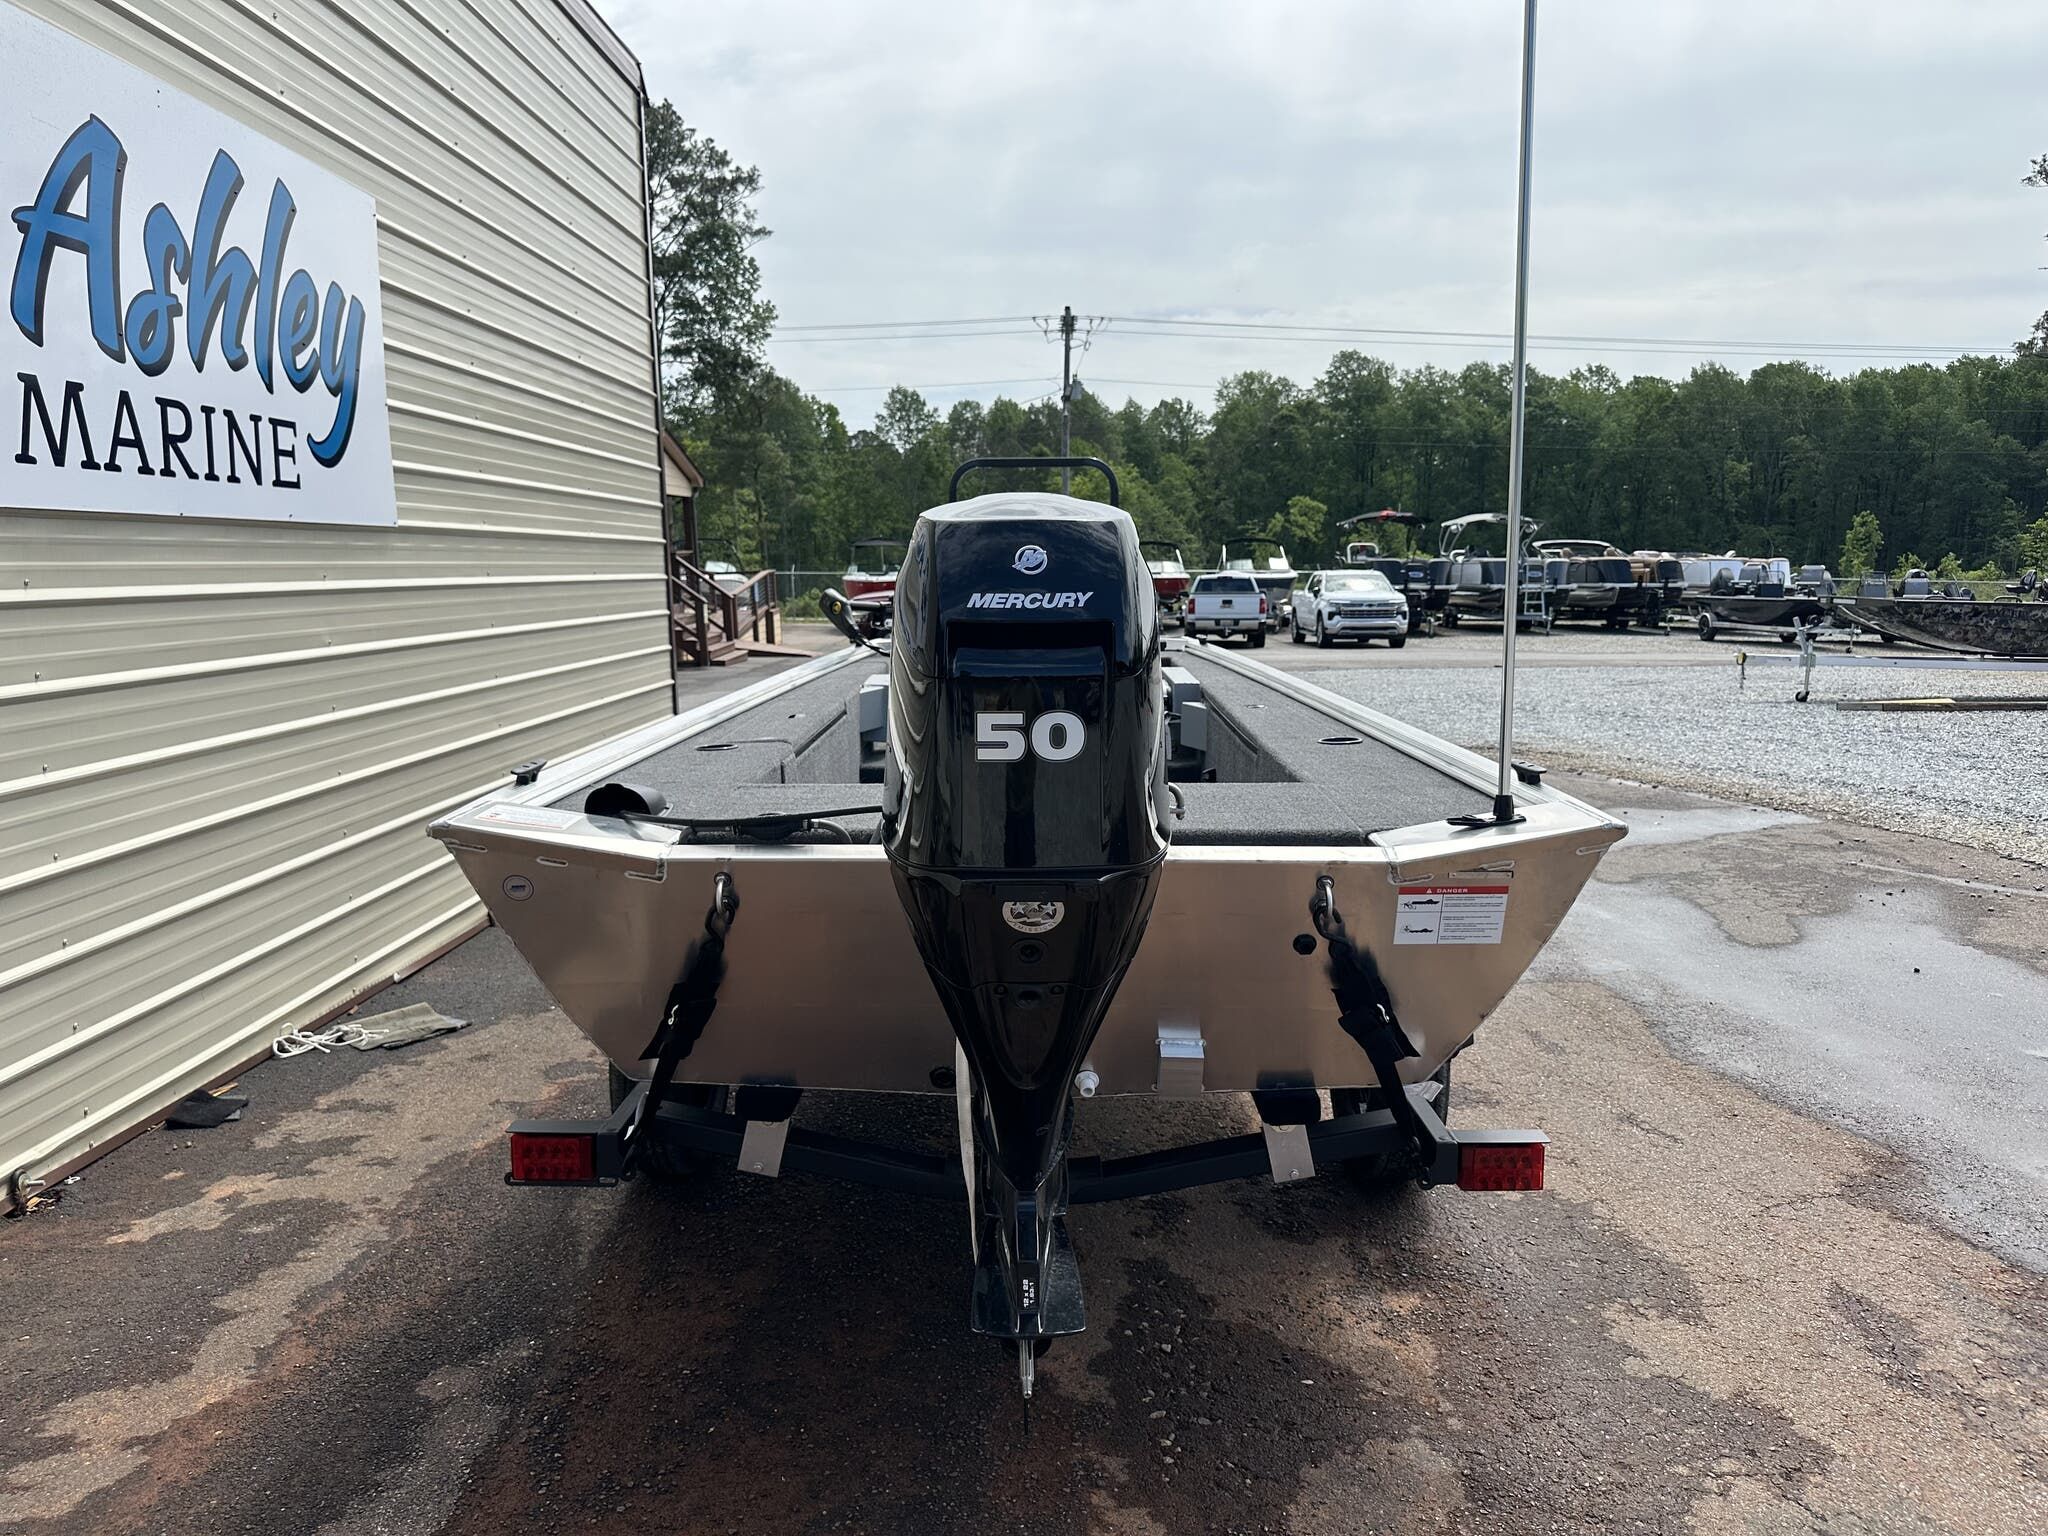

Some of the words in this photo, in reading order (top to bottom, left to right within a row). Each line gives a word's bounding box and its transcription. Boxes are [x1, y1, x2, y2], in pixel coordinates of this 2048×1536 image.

[10, 113, 366, 468] Ashley
[15, 372, 301, 489] MARINE
[967, 592, 1094, 609] MERCURY
[975, 710, 1087, 762] 50
